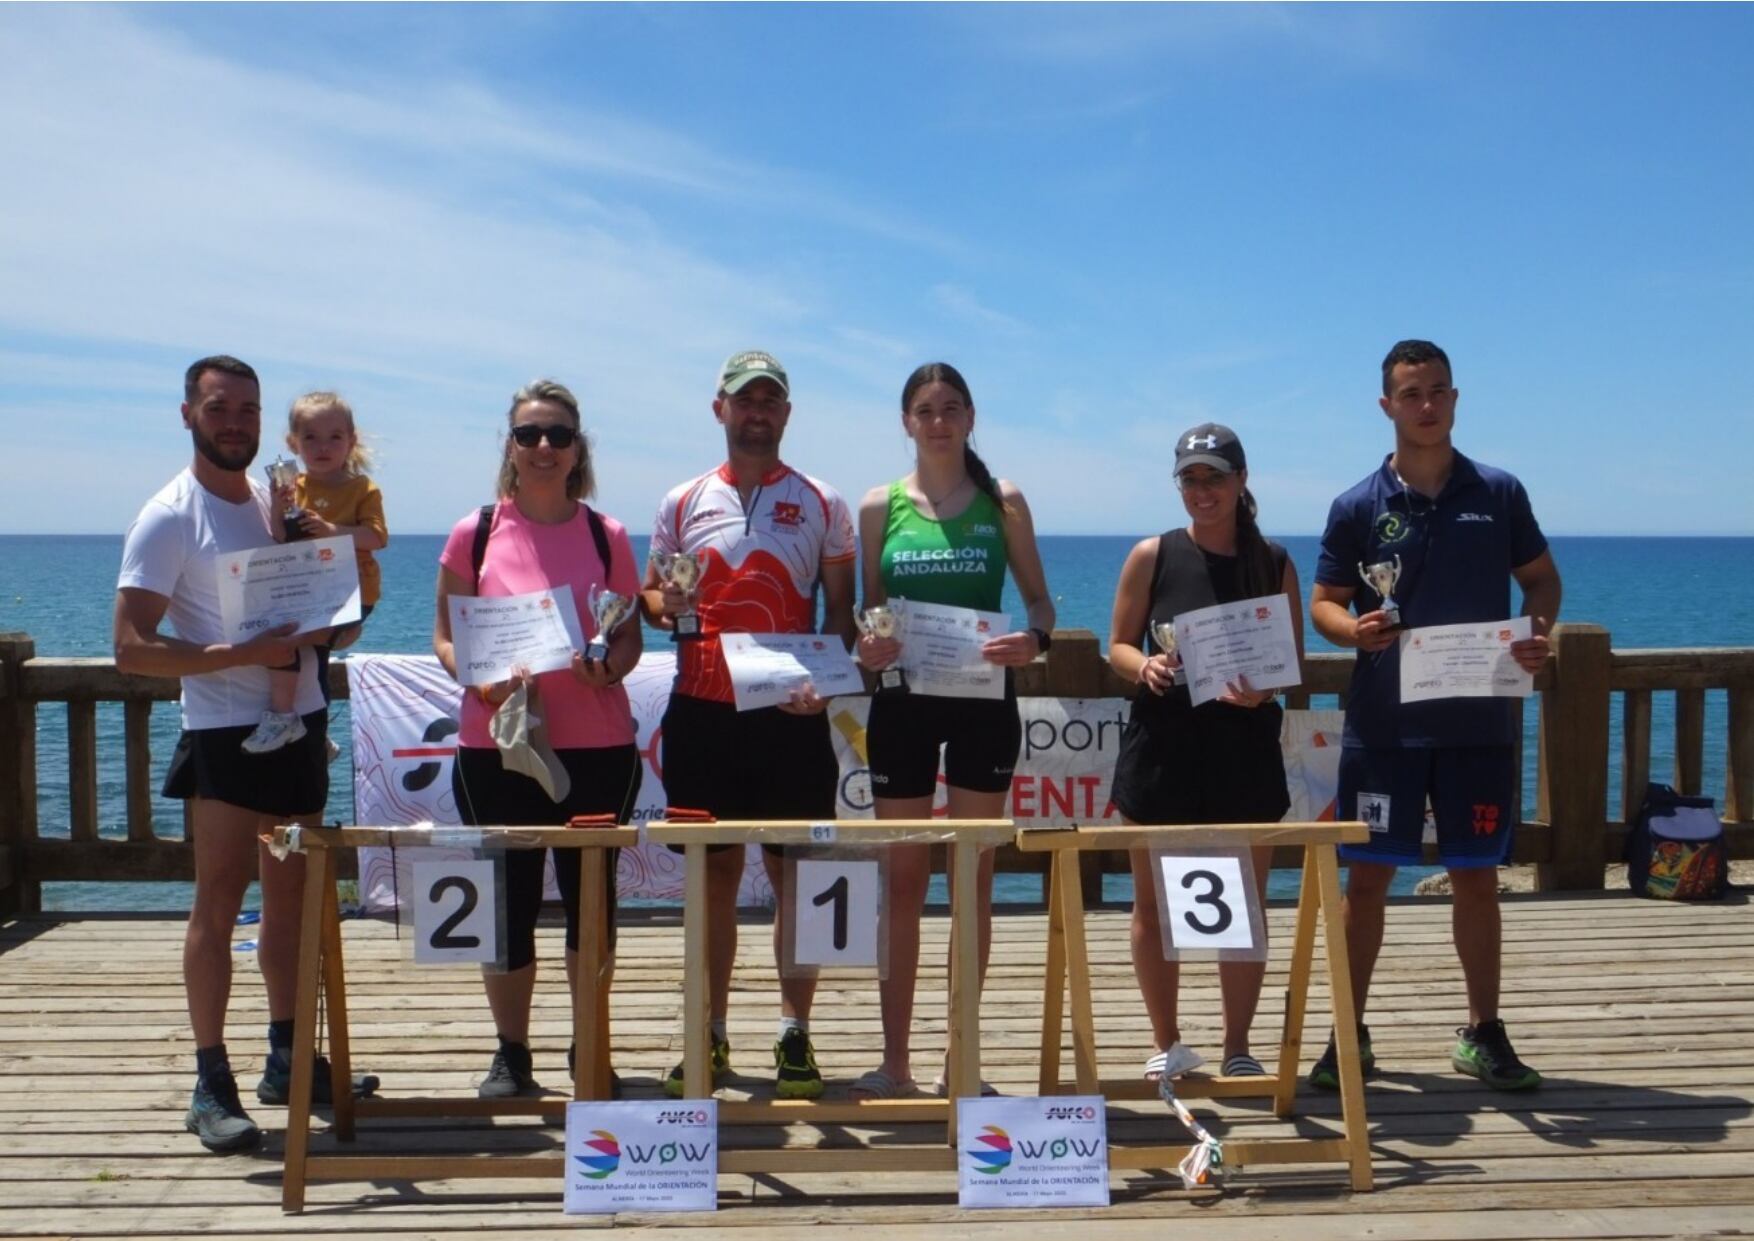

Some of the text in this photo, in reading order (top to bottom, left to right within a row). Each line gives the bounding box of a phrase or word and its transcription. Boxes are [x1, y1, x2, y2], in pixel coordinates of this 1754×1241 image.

[892, 545, 988, 563] SELECCIÓN
[893, 560, 987, 577] ANDALUZA
[1025, 711, 1130, 761] port
[632, 803, 665, 820] orie
[813, 827, 831, 839] 61
[1181, 869, 1233, 935] 3
[429, 875, 481, 949] 2
[812, 876, 848, 951] 1
[648, 1168, 689, 1177] Orienteering
[1040, 1164, 1081, 1172] Orienteering
[575, 1183, 604, 1191] Semana
[650, 1182, 656, 1190] la
[657, 1180, 709, 1189] ORIENTACIÓN
[1050, 1176, 1100, 1184] ORIENTACIÓN
